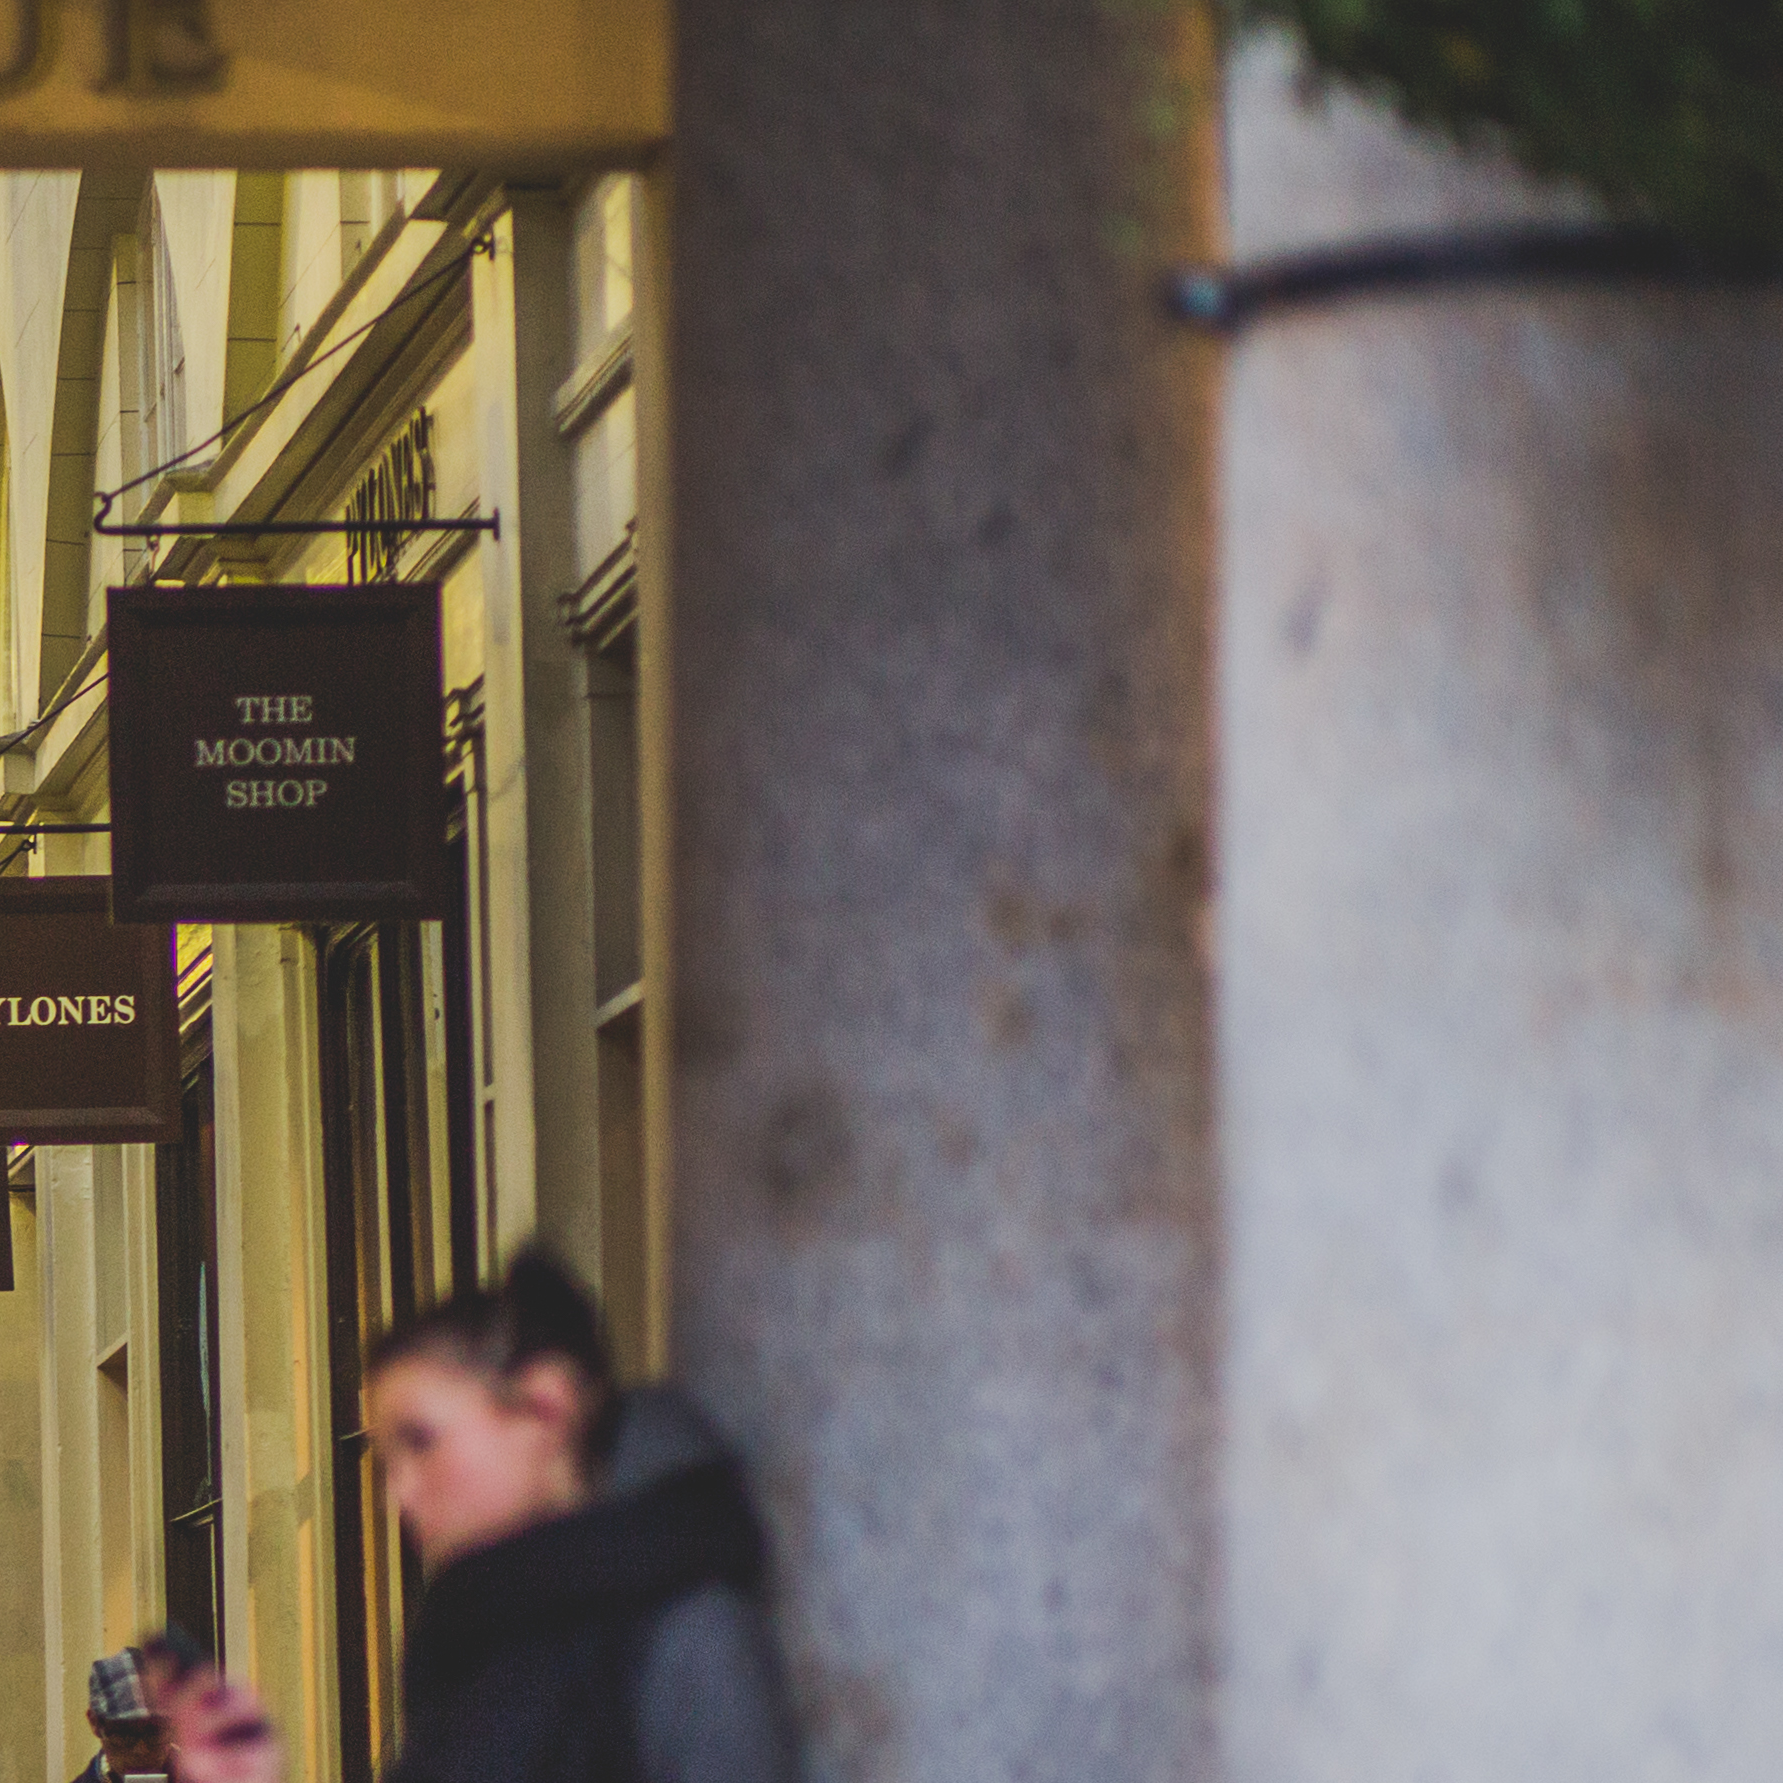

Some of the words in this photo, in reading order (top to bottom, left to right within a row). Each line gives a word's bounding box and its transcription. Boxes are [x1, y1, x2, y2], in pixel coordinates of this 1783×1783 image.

[236, 696, 314, 724] THE
[196, 738, 355, 766] MOOMIN
[227, 779, 327, 807] SHOP
